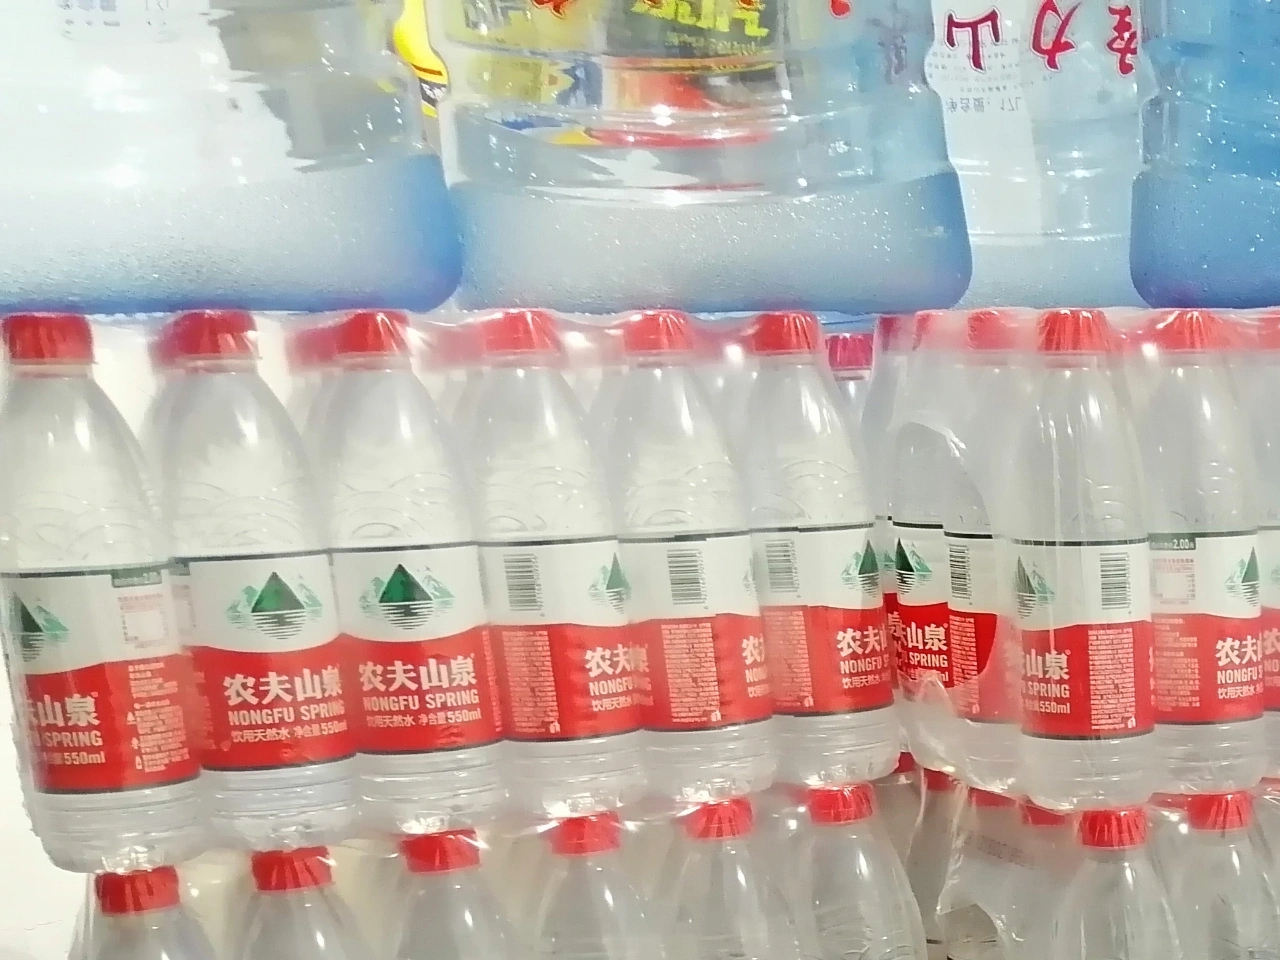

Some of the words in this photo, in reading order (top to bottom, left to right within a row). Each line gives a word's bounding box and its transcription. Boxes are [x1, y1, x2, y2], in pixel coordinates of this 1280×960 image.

[840, 657, 882, 674] NONGFU
[909, 652, 948, 668] SPRING
[358, 654, 477, 692] 农夫山泉
[1217, 668, 1258, 684] NONGFU
[224, 665, 343, 706] 农夫山泉
[1028, 683, 1070, 698] SPRING
[363, 693, 419, 712] NONGFU
[426, 689, 479, 709] SPRING
[228, 707, 294, 726] NONGFU
[301, 699, 345, 720] SPRING
[46, 729, 103, 747] SPRING
